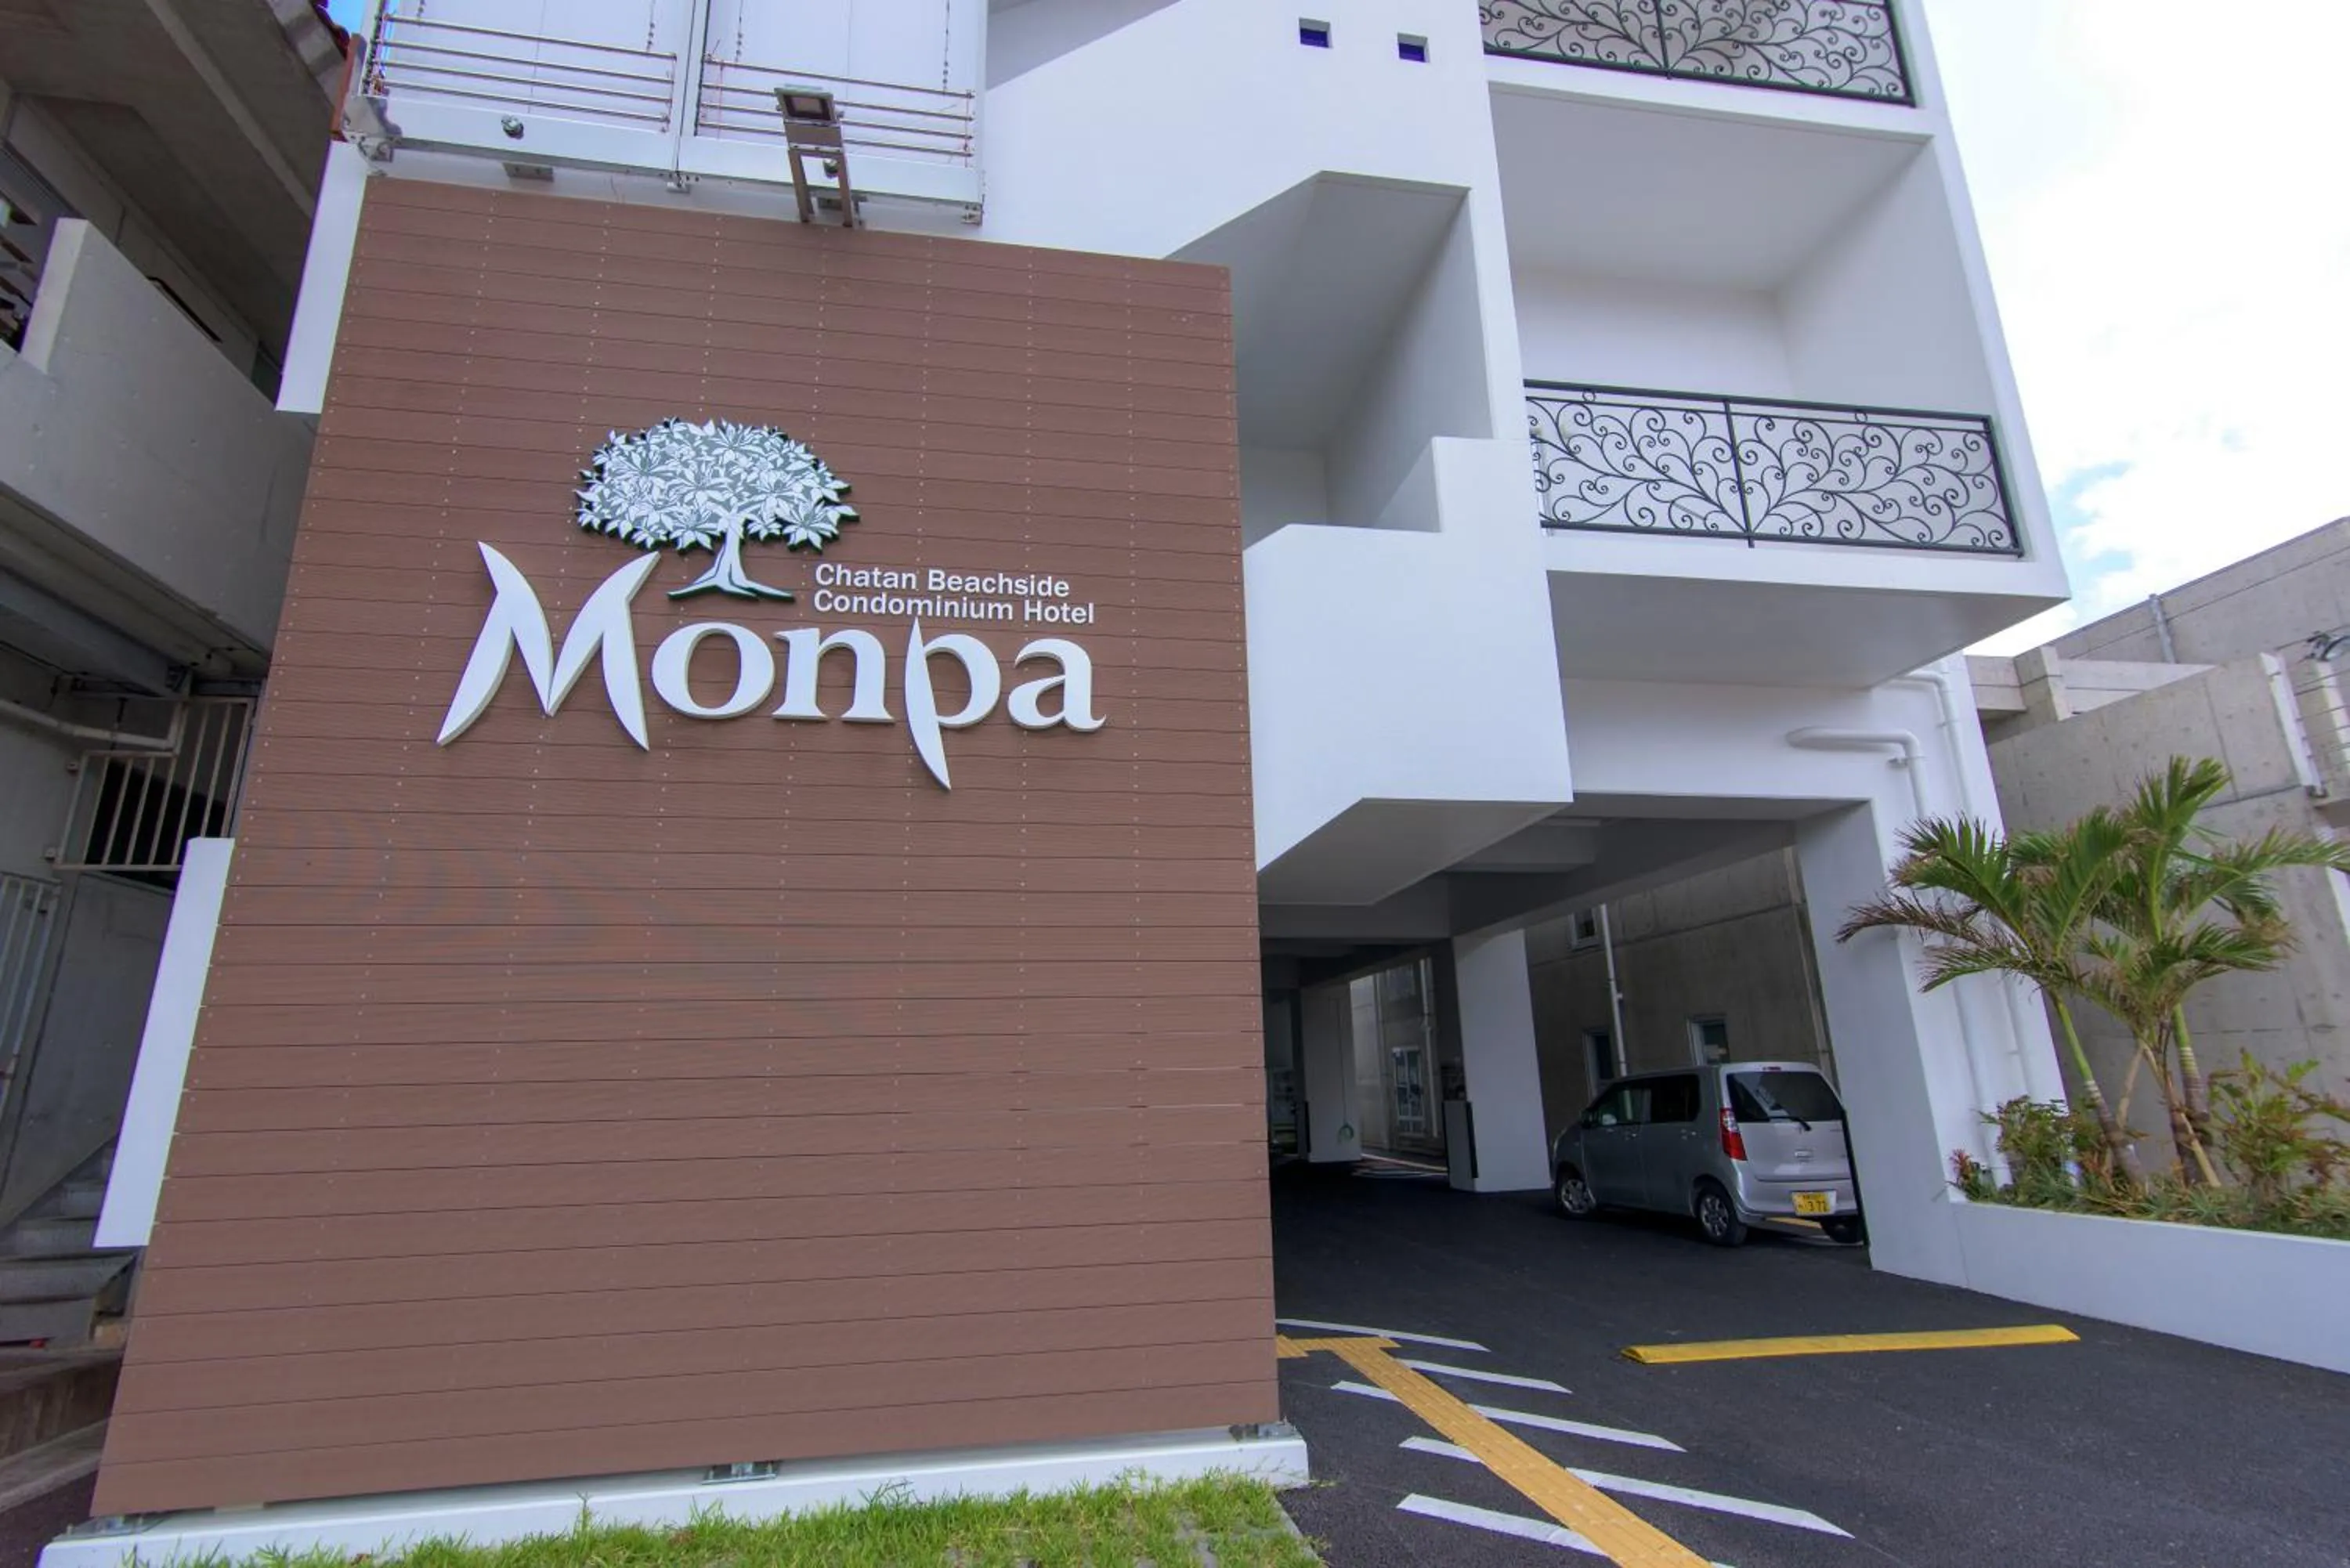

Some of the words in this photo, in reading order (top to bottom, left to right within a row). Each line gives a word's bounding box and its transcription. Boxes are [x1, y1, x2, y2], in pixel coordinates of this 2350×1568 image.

[815, 563, 917, 590] Chatan
[927, 569, 1070, 598] Beachside
[813, 589, 1013, 621] Condominium
[1023, 599, 1095, 624] Hotel
[436, 540, 1107, 790] Monpa
